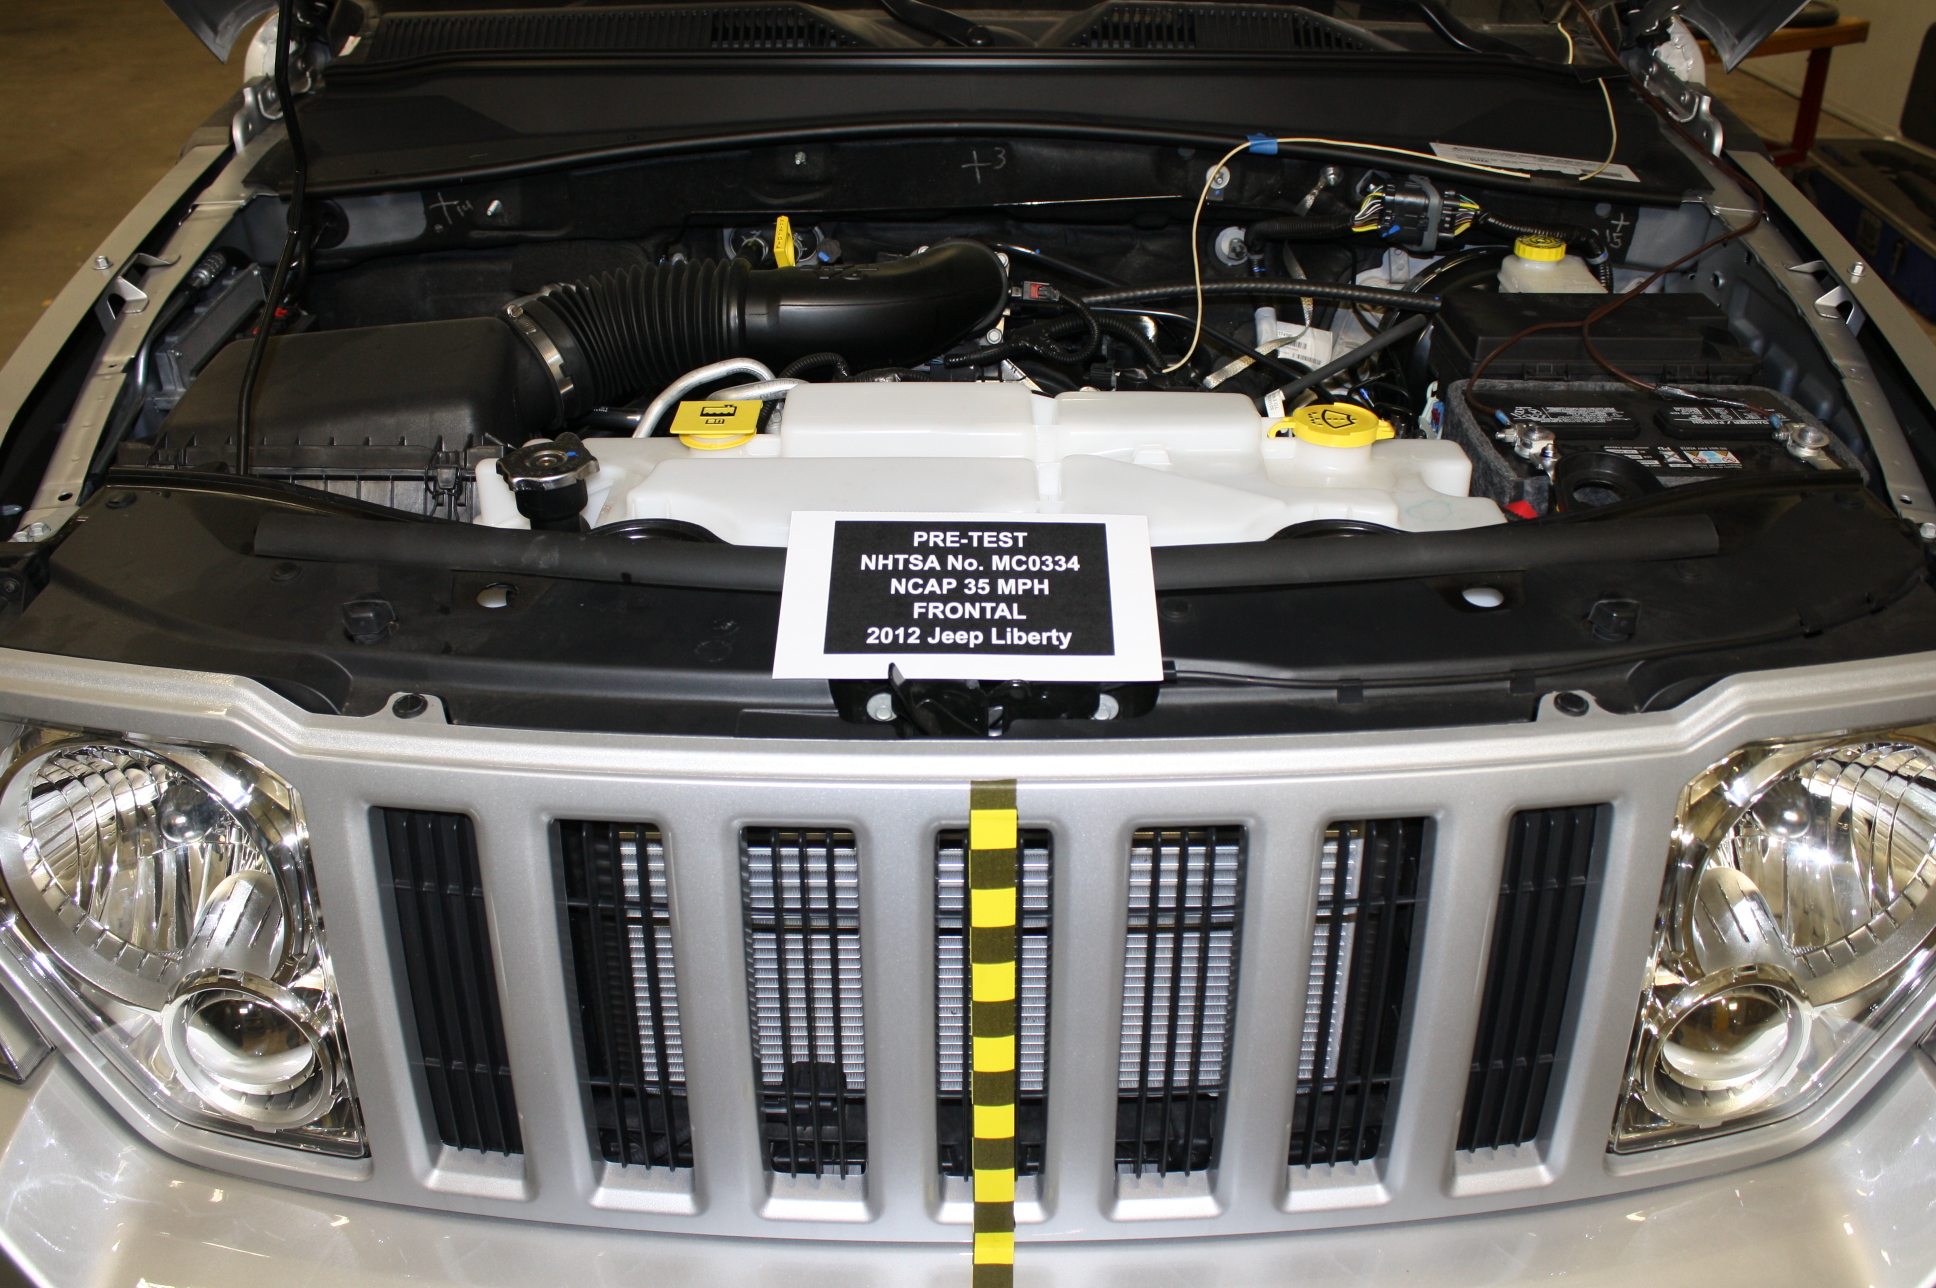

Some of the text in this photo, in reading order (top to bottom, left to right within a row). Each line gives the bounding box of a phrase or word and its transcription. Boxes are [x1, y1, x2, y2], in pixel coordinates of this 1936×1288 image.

[913, 531, 1028, 548] PRE-TEST
[860, 553, 1081, 572] NHTSA No. MC0334
[890, 577, 1050, 595] NCAP 35 MPH
[913, 601, 1027, 620] FRONTAL
[865, 626, 1073, 650] 2012 Jeep Liberty
